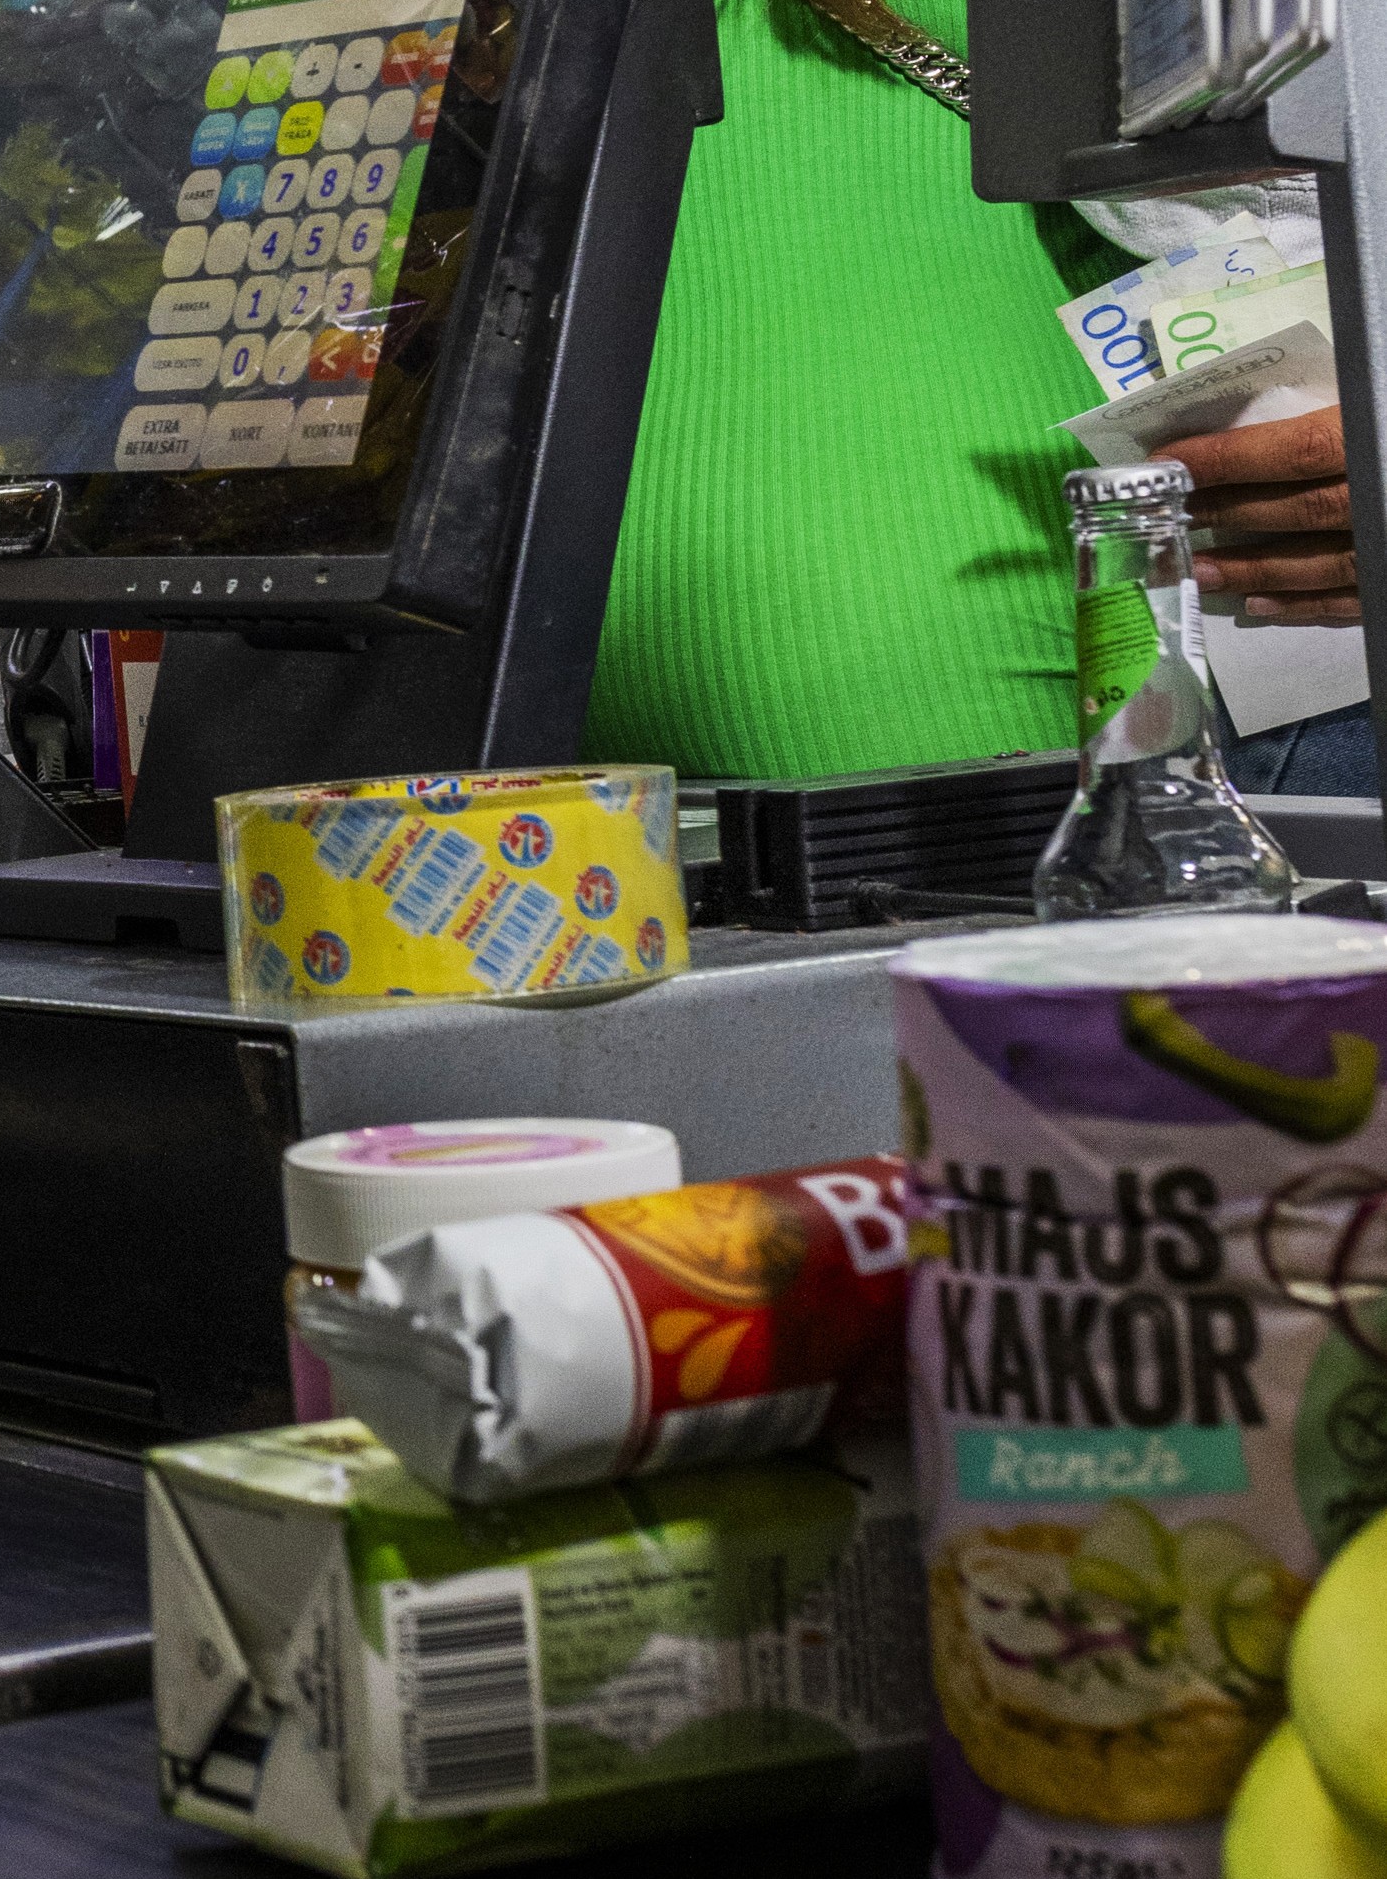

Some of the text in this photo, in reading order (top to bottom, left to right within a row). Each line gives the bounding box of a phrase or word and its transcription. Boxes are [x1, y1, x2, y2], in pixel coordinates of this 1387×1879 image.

[275, 163, 384, 203] 7 8 9
[261, 223, 369, 260] 4 5 6
[247, 282, 355, 319] 1 2 3
[232, 347, 250, 377] 0
[1081, 303, 1162, 391] 100
[142, 419, 180, 434] EXTRA
[945, 1160, 1223, 1287] MAJS
[938, 1280, 1267, 1430] KAKOR
[988, 1434, 1187, 1490] Ranch
